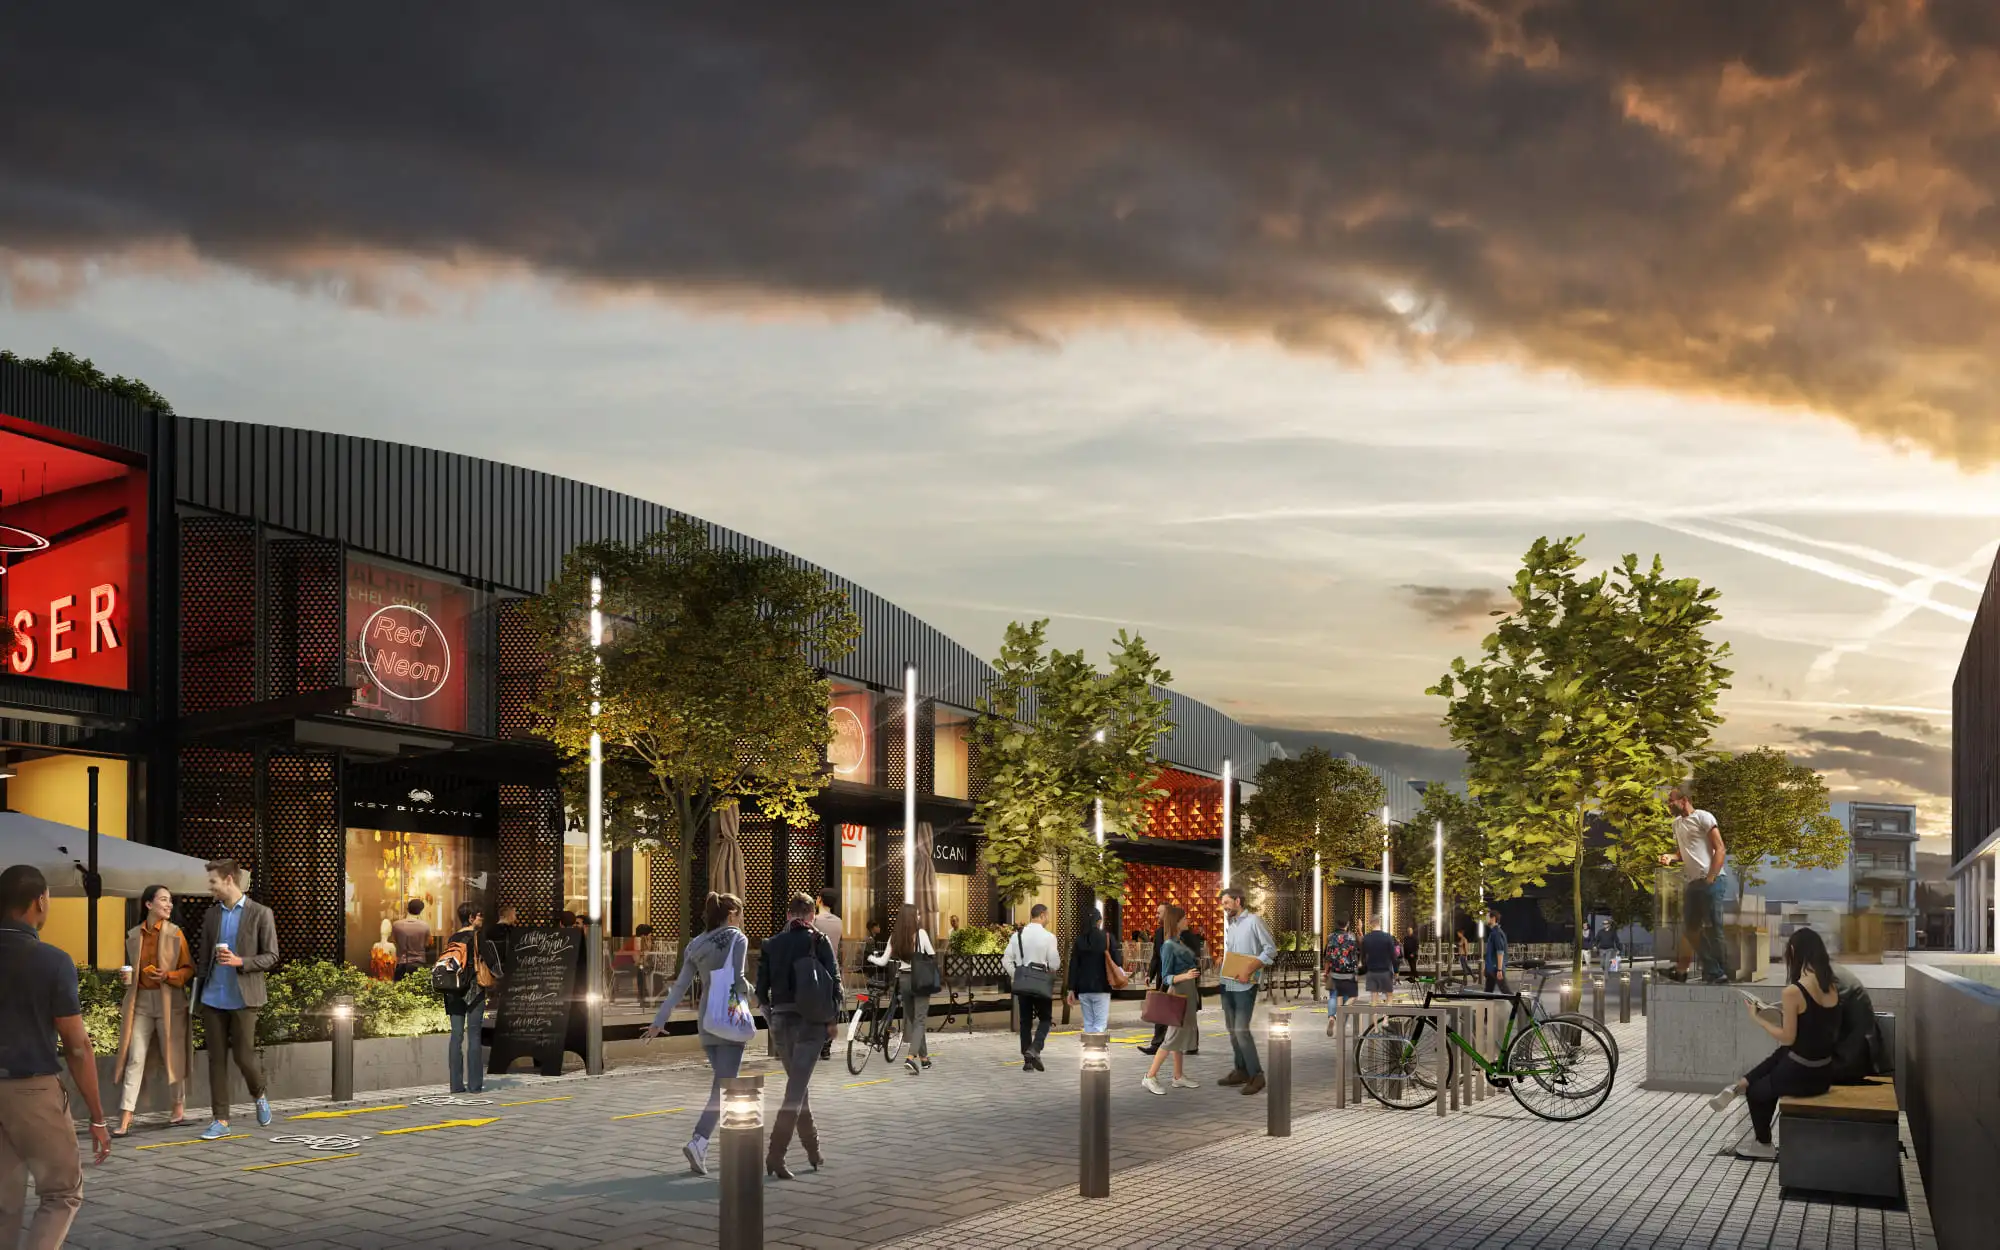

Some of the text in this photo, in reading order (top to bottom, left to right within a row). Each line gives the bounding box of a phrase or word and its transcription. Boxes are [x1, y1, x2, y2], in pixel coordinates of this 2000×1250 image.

[11, 583, 119, 673] SER
[373, 615, 427, 648] Red
[373, 649, 440, 683] Neon
[353, 801, 389, 810] KEY
